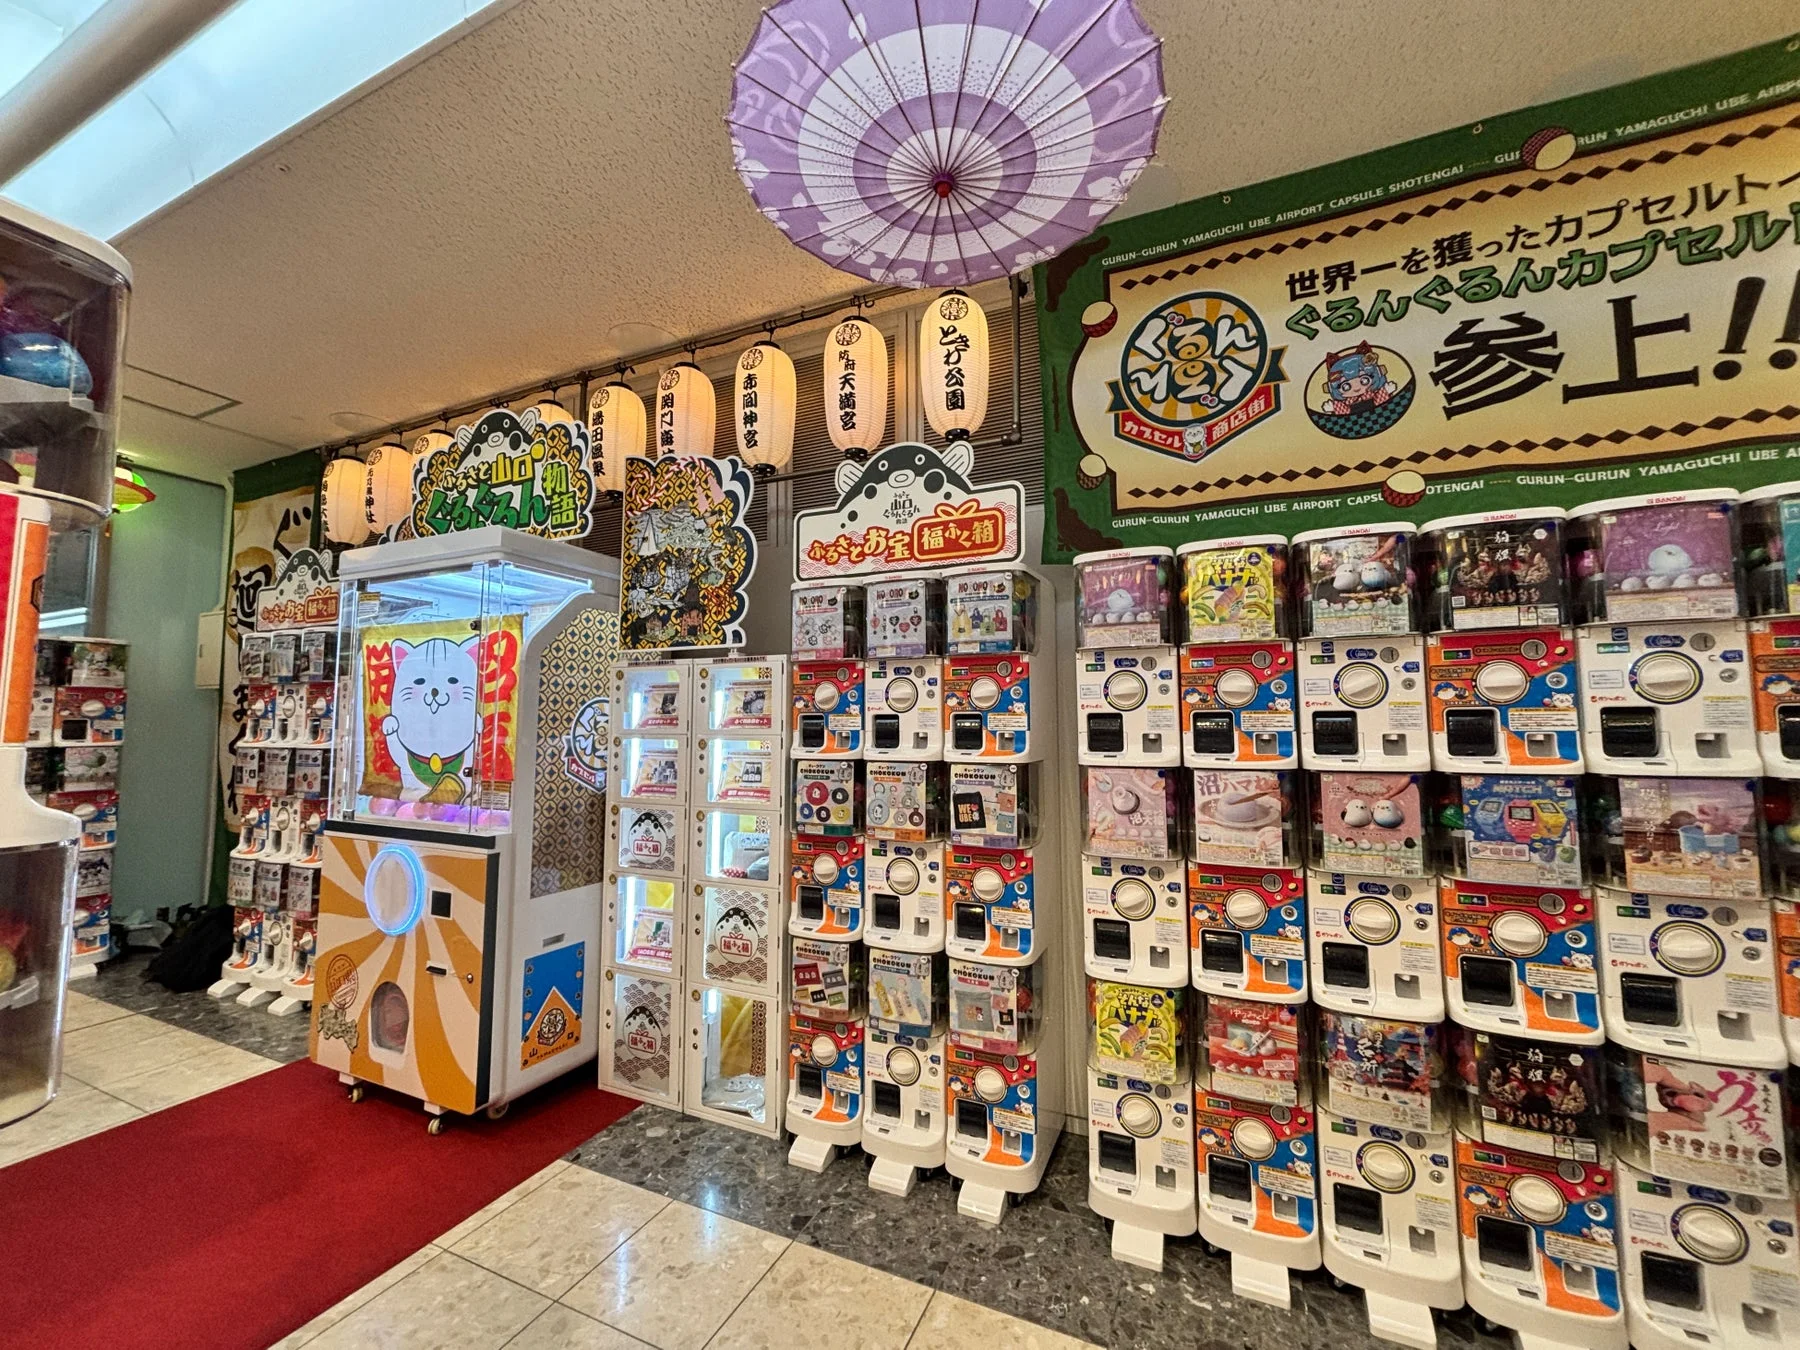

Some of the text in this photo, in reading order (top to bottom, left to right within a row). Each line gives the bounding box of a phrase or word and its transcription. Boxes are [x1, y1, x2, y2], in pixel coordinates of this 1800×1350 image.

[1182, 222, 1244, 245] YAMAGUCHI
[1248, 216, 1271, 228] UBE
[1276, 203, 1323, 222] AIRPORT
[1330, 188, 1384, 208] CAPSULE
[1389, 164, 1464, 193] SHOTENGAI
[1615, 105, 1708, 137] YAMAGUCHI
[1715, 93, 1750, 111] UBE
[939, 324, 970, 411] ときわ公園
[1124, 395, 1266, 449] カプセル 商店街
[543, 461, 577, 528] 物語
[890, 499, 913, 511] 山口
[1195, 507, 1260, 523] YAMAGUCHI
[1264, 503, 1288, 514] UBE
[1292, 498, 1342, 511] AIRPORT
[1639, 453, 1741, 477] YAMAGUCHI
[1749, 449, 1778, 461] UBE
[920, 519, 995, 550] 福ふく箱
